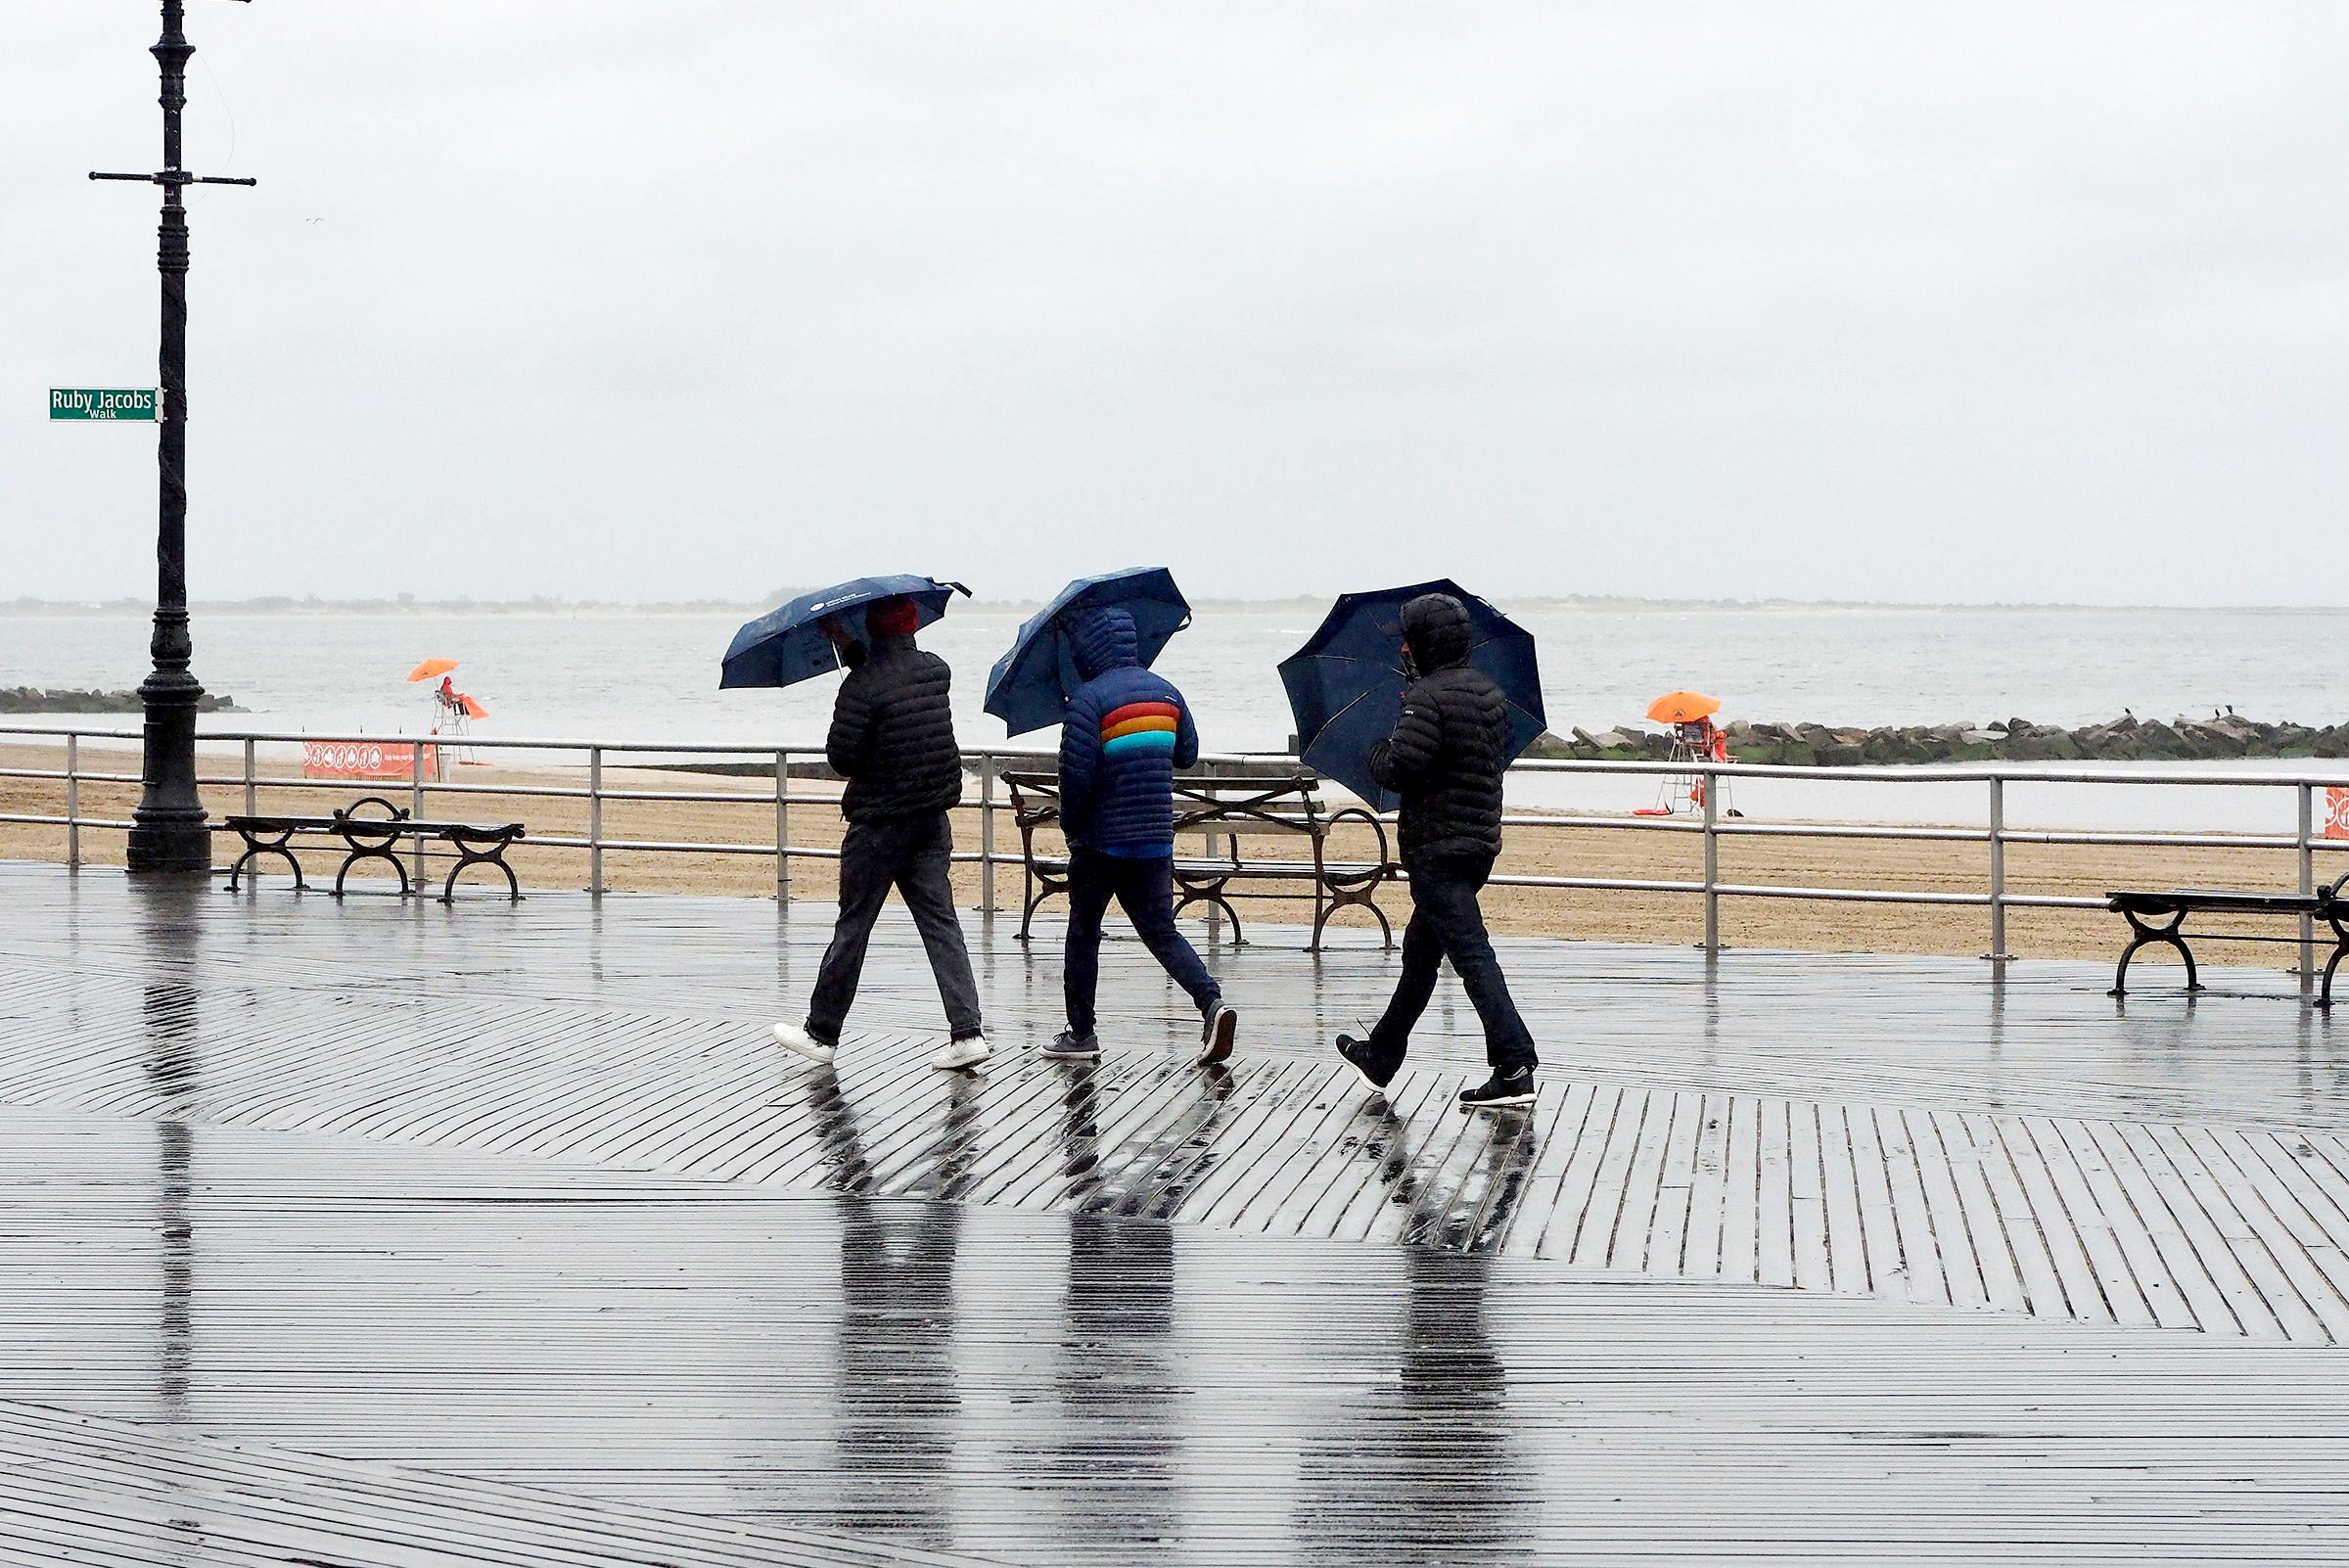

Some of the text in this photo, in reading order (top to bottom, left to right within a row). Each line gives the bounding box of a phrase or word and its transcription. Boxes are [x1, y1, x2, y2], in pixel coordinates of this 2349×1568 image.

[53, 390, 152, 413] Ruby Jacobs
[89, 408, 117, 419] Walk
